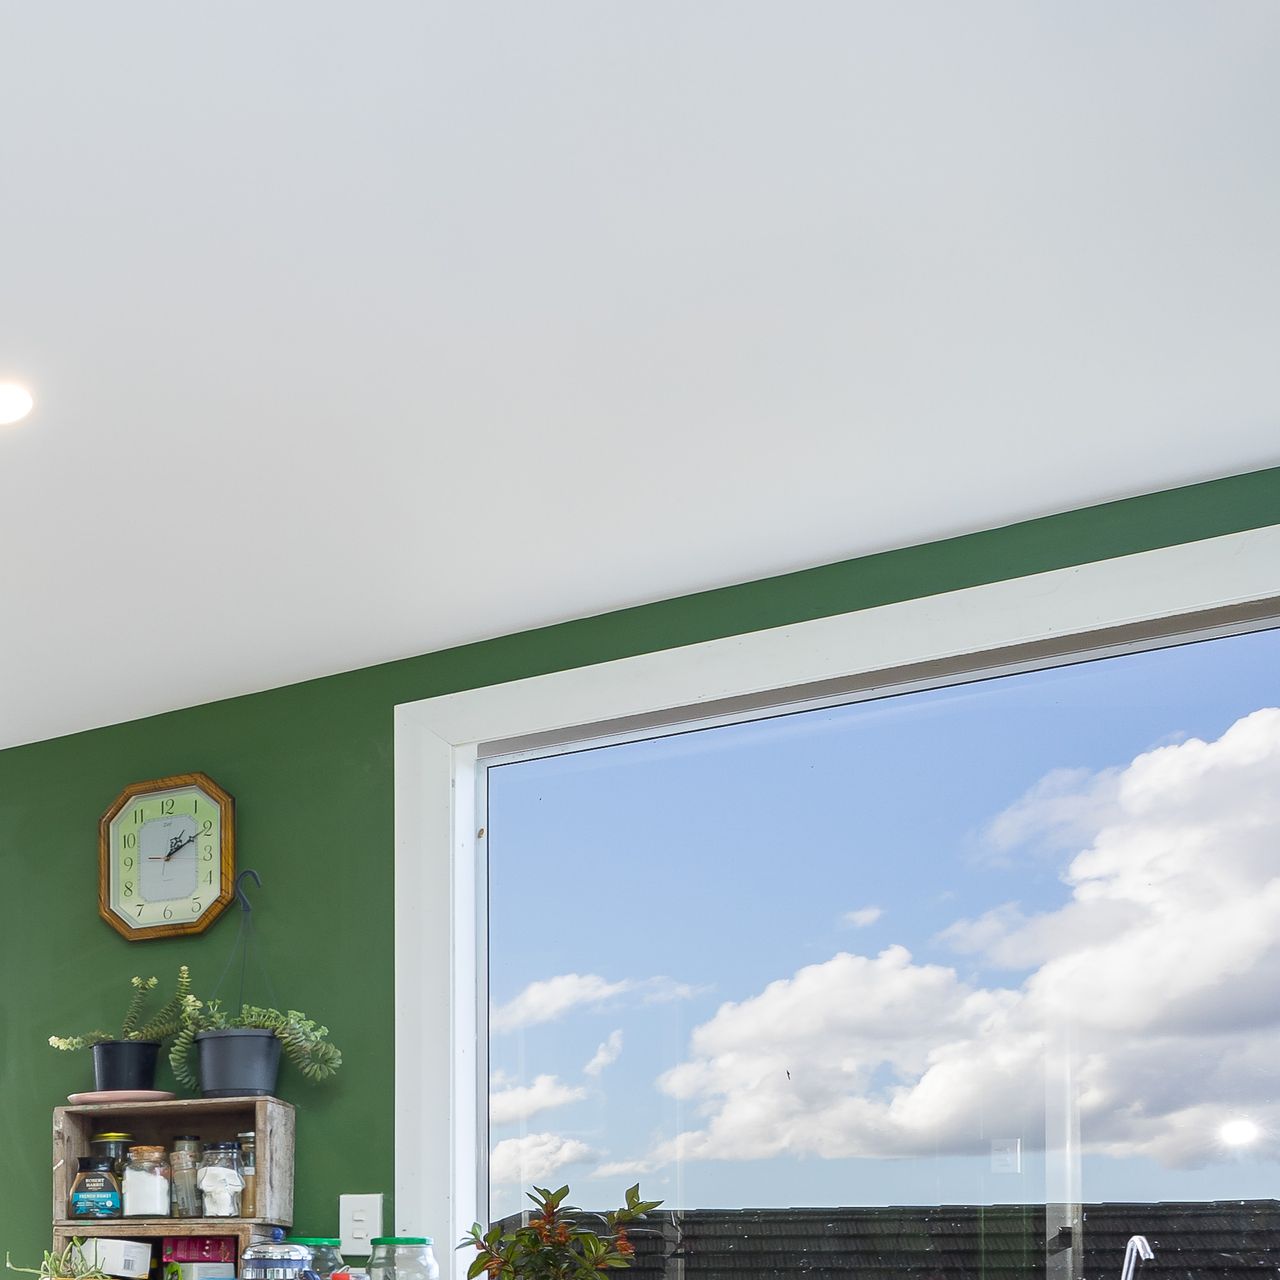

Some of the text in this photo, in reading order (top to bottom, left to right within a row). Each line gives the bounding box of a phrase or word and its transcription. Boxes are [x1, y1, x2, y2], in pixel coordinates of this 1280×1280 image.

[161, 799, 175, 815] 12
[134, 808, 144, 824] 11
[202, 820, 212, 836] 2
[123, 832, 136, 848] 10
[203, 845, 212, 861] 3
[124, 857, 134, 872] 9
[203, 870, 212, 884] 4
[124, 881, 134, 897] 8
[136, 904, 144, 918] 7
[163, 905, 172, 920] 6
[192, 896, 202, 913] 5
